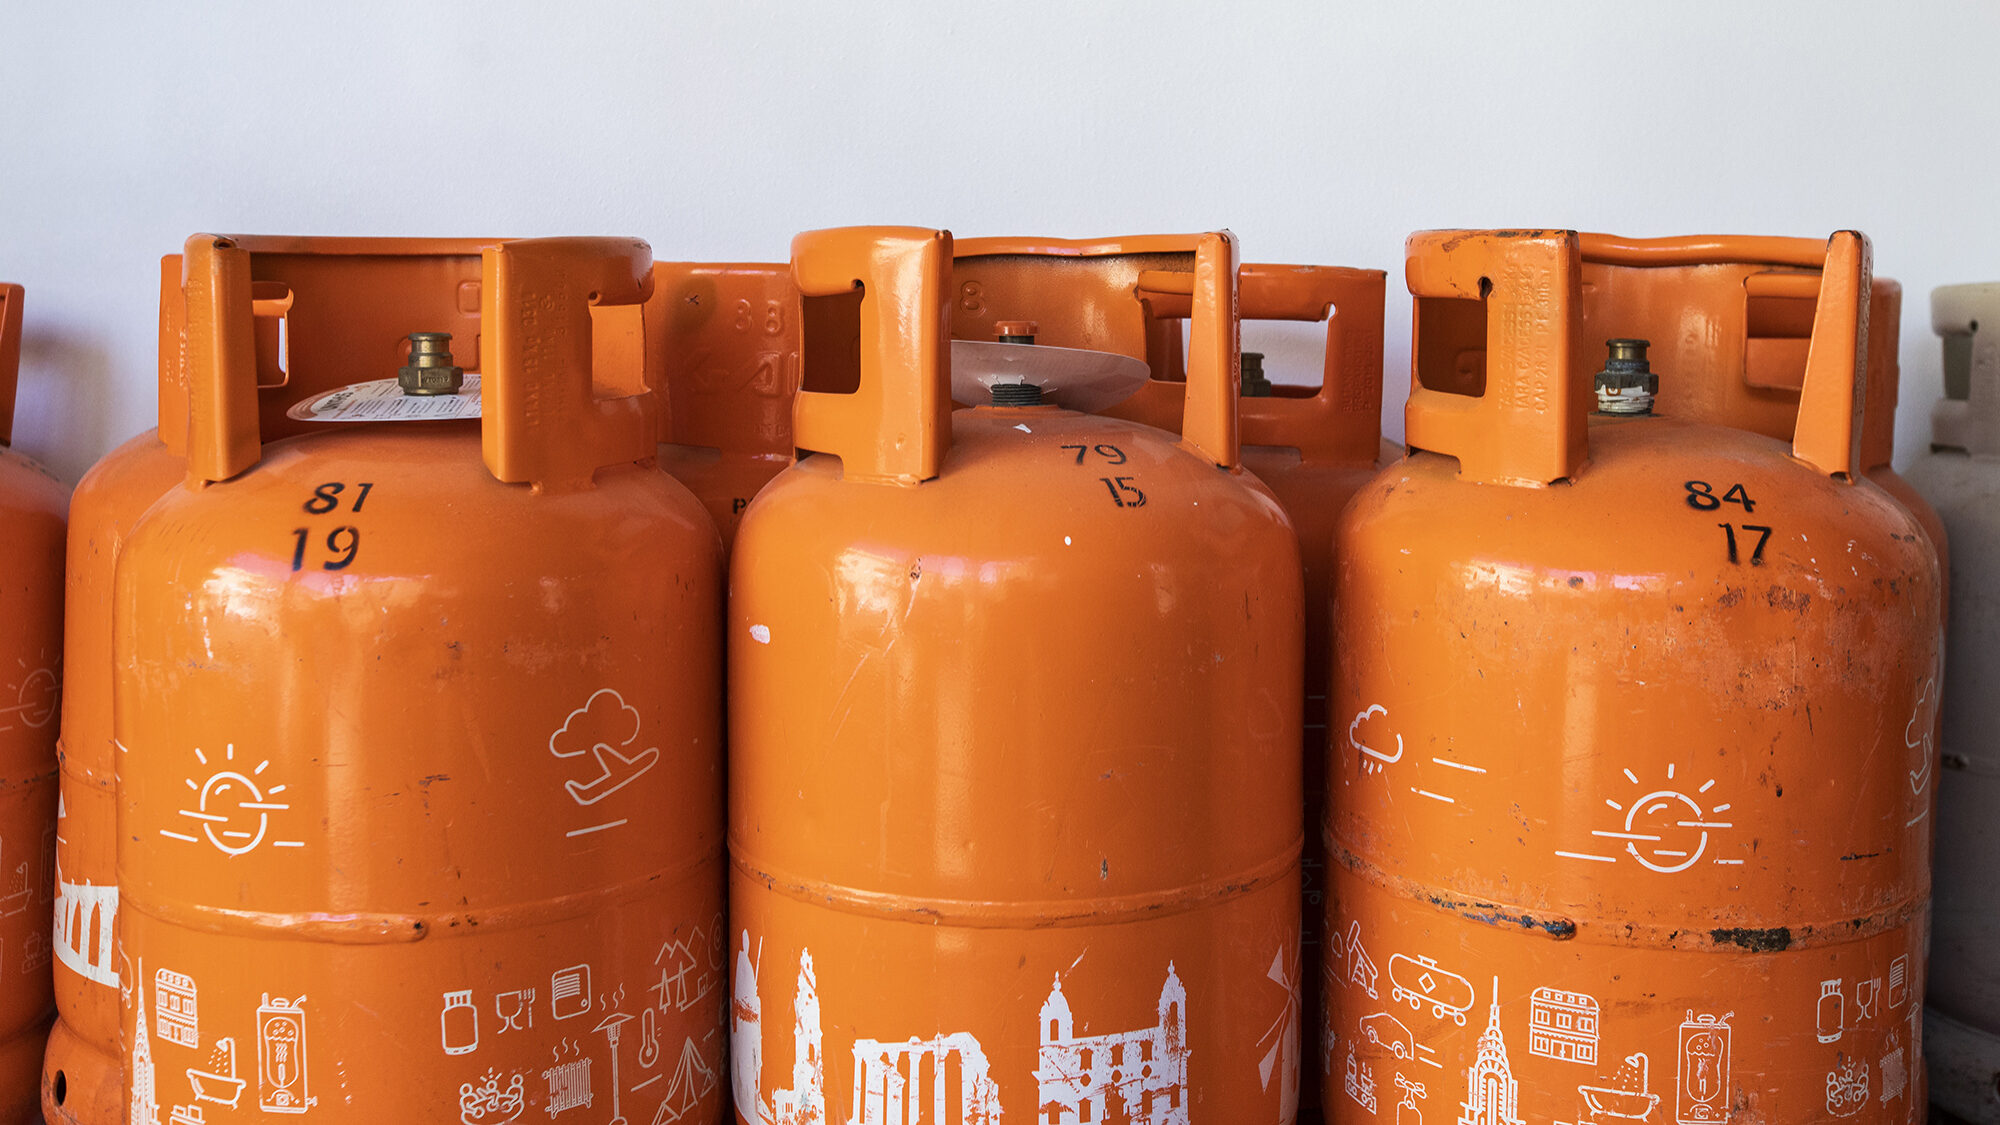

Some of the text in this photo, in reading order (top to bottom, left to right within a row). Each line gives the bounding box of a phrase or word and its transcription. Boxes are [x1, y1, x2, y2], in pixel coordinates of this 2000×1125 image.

[1060, 444, 1126, 465] 79
[302, 482, 373, 515] 81
[1099, 477, 1146, 507] 15
[1684, 480, 1756, 512] 84
[291, 526, 360, 571] 19
[1717, 522, 1772, 567] 17
